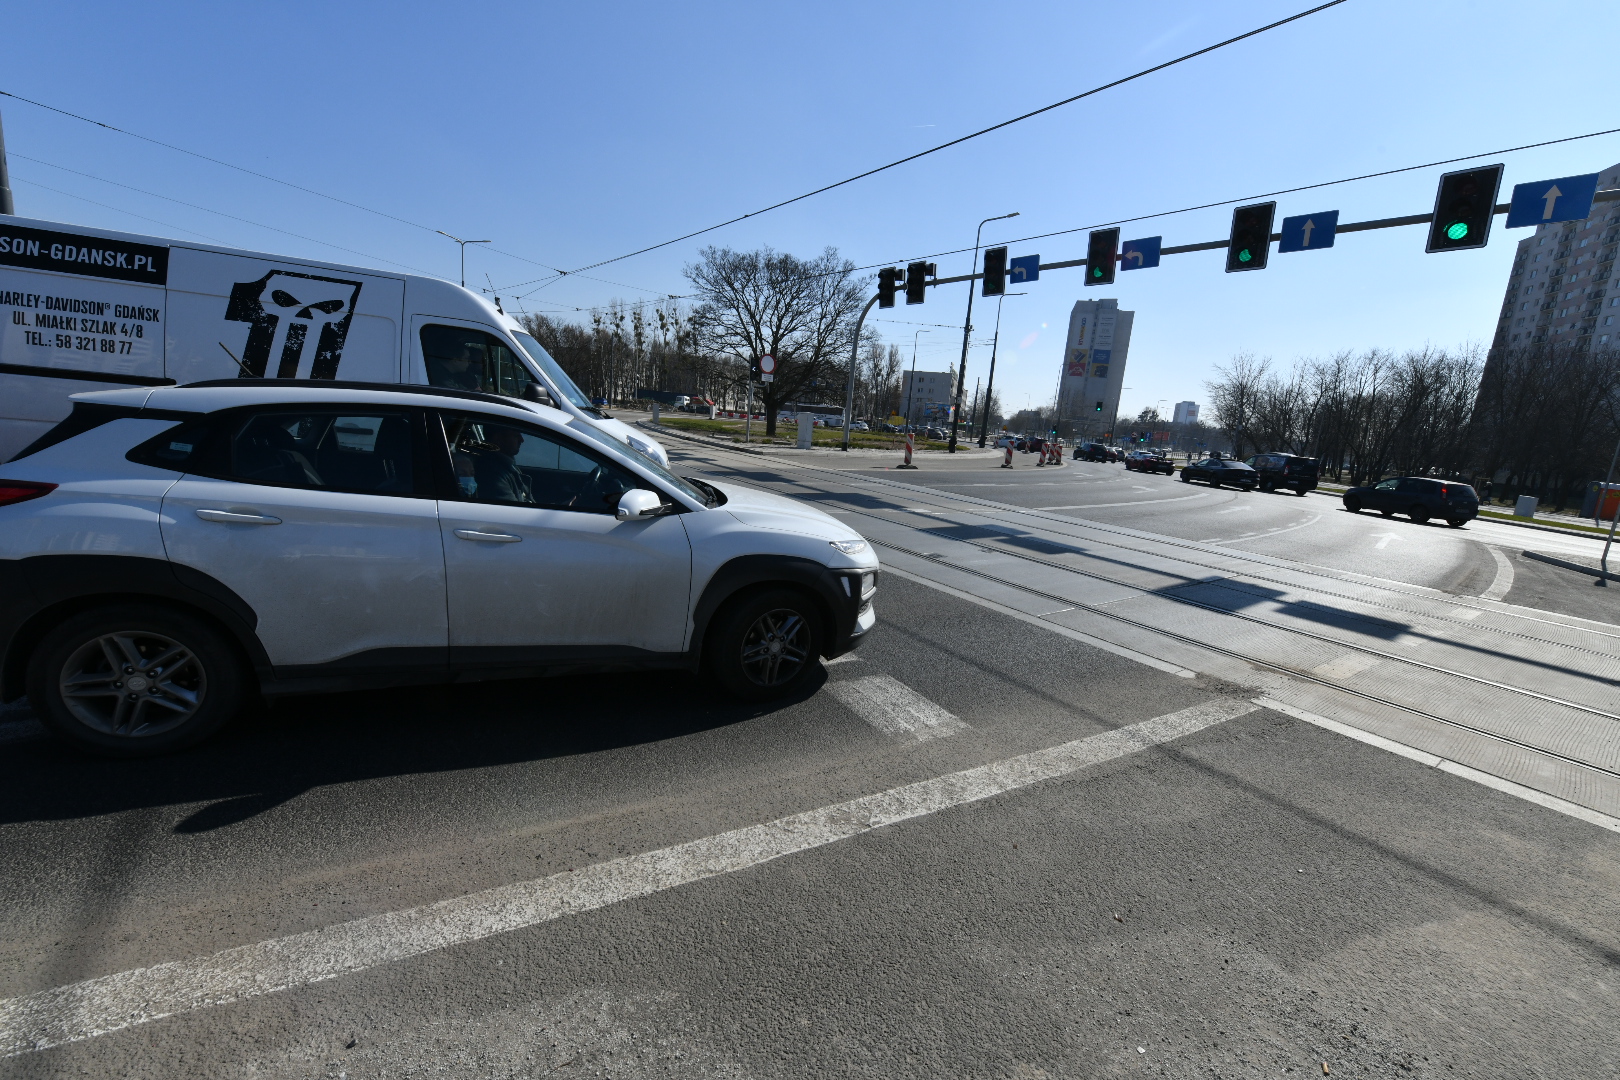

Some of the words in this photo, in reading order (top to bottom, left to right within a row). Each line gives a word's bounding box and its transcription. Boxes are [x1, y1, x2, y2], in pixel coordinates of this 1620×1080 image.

[0, 236, 157, 273] SON-GDANSK.PL
[13, 310, 31, 327] UL.
[35, 313, 77, 332] MIAŁKI
[80, 318, 117, 336] SZLAK
[120, 322, 144, 339] 4/8
[114, 304, 160, 323] GDAŃSK
[24, 330, 52, 348] TEL.:
[55, 334, 72, 349] 58
[75, 336, 96, 352] 321
[100, 340, 116, 355] 88
[119, 340, 133, 355] 77
